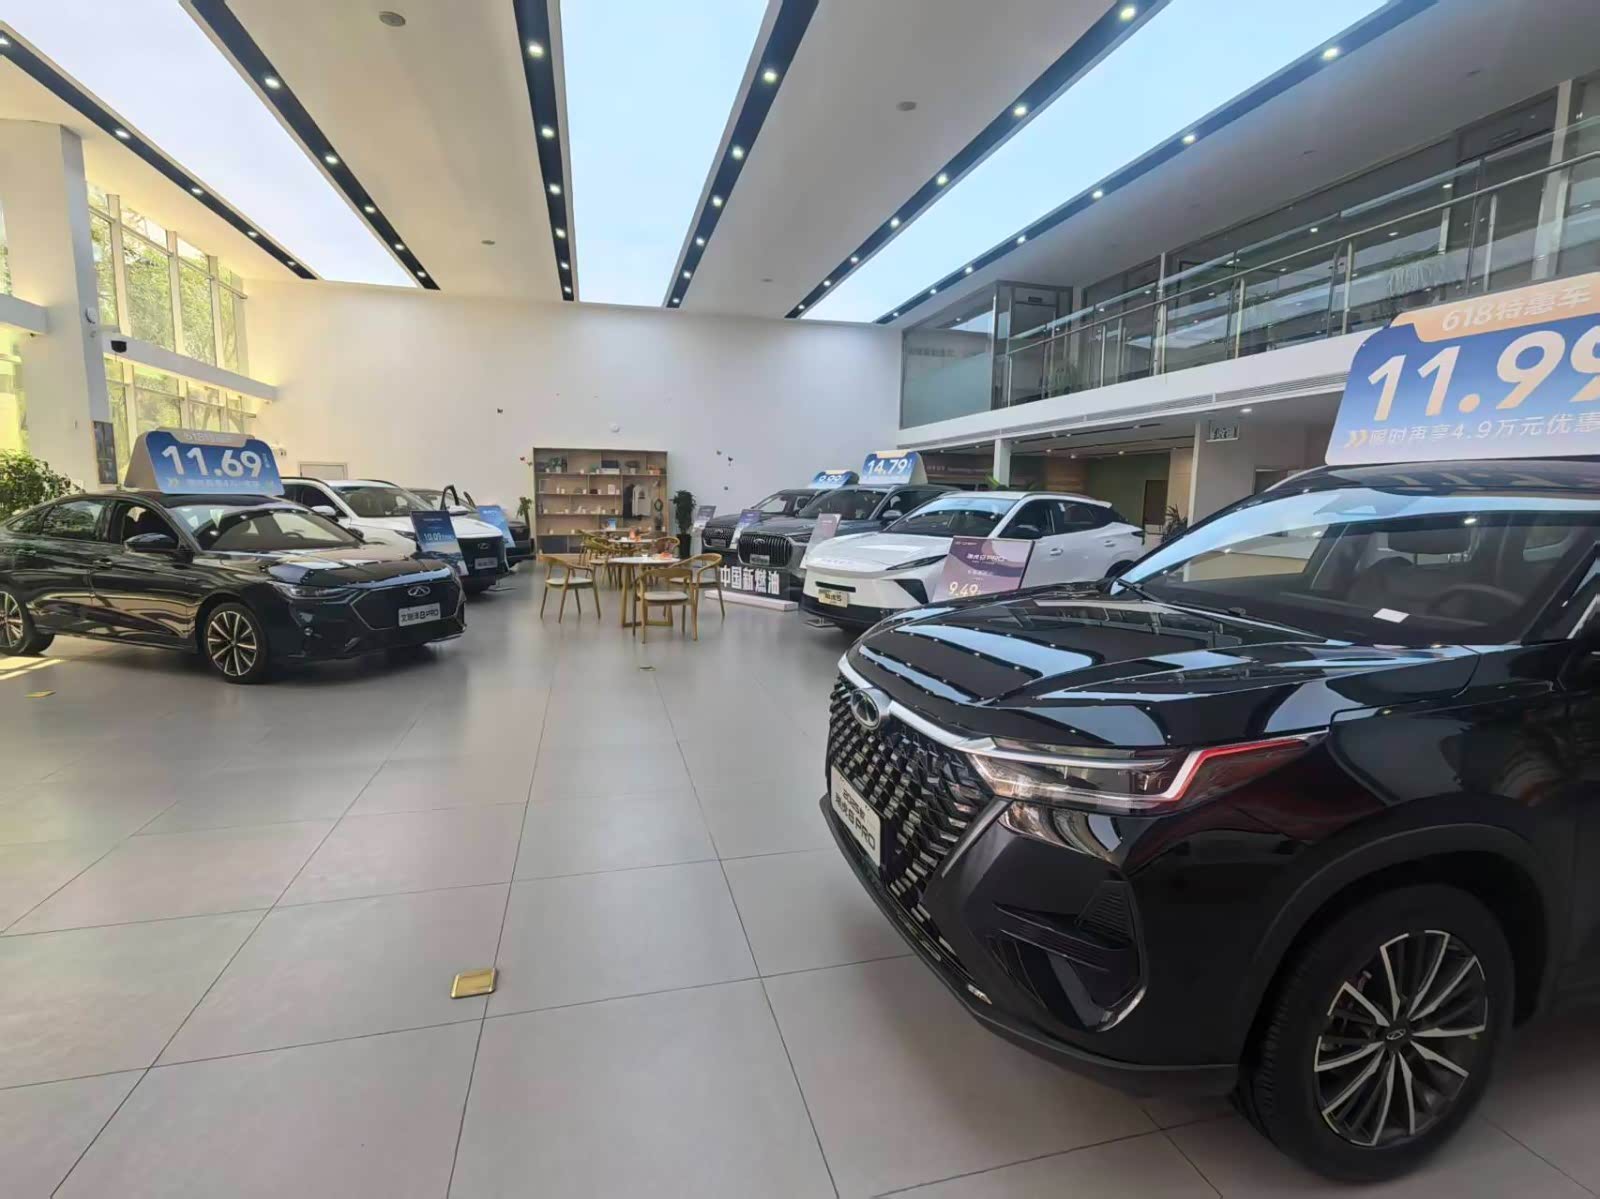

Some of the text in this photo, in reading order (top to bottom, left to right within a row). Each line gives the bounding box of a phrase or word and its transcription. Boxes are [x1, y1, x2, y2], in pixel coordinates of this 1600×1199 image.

[1441, 286, 1592, 331] 618特惠车
[162, 446, 262, 478] 11.69
[867, 459, 908, 475] 14.79
[720, 565, 780, 595] 中国新燃油
[949, 581, 979, 597] 9.49
